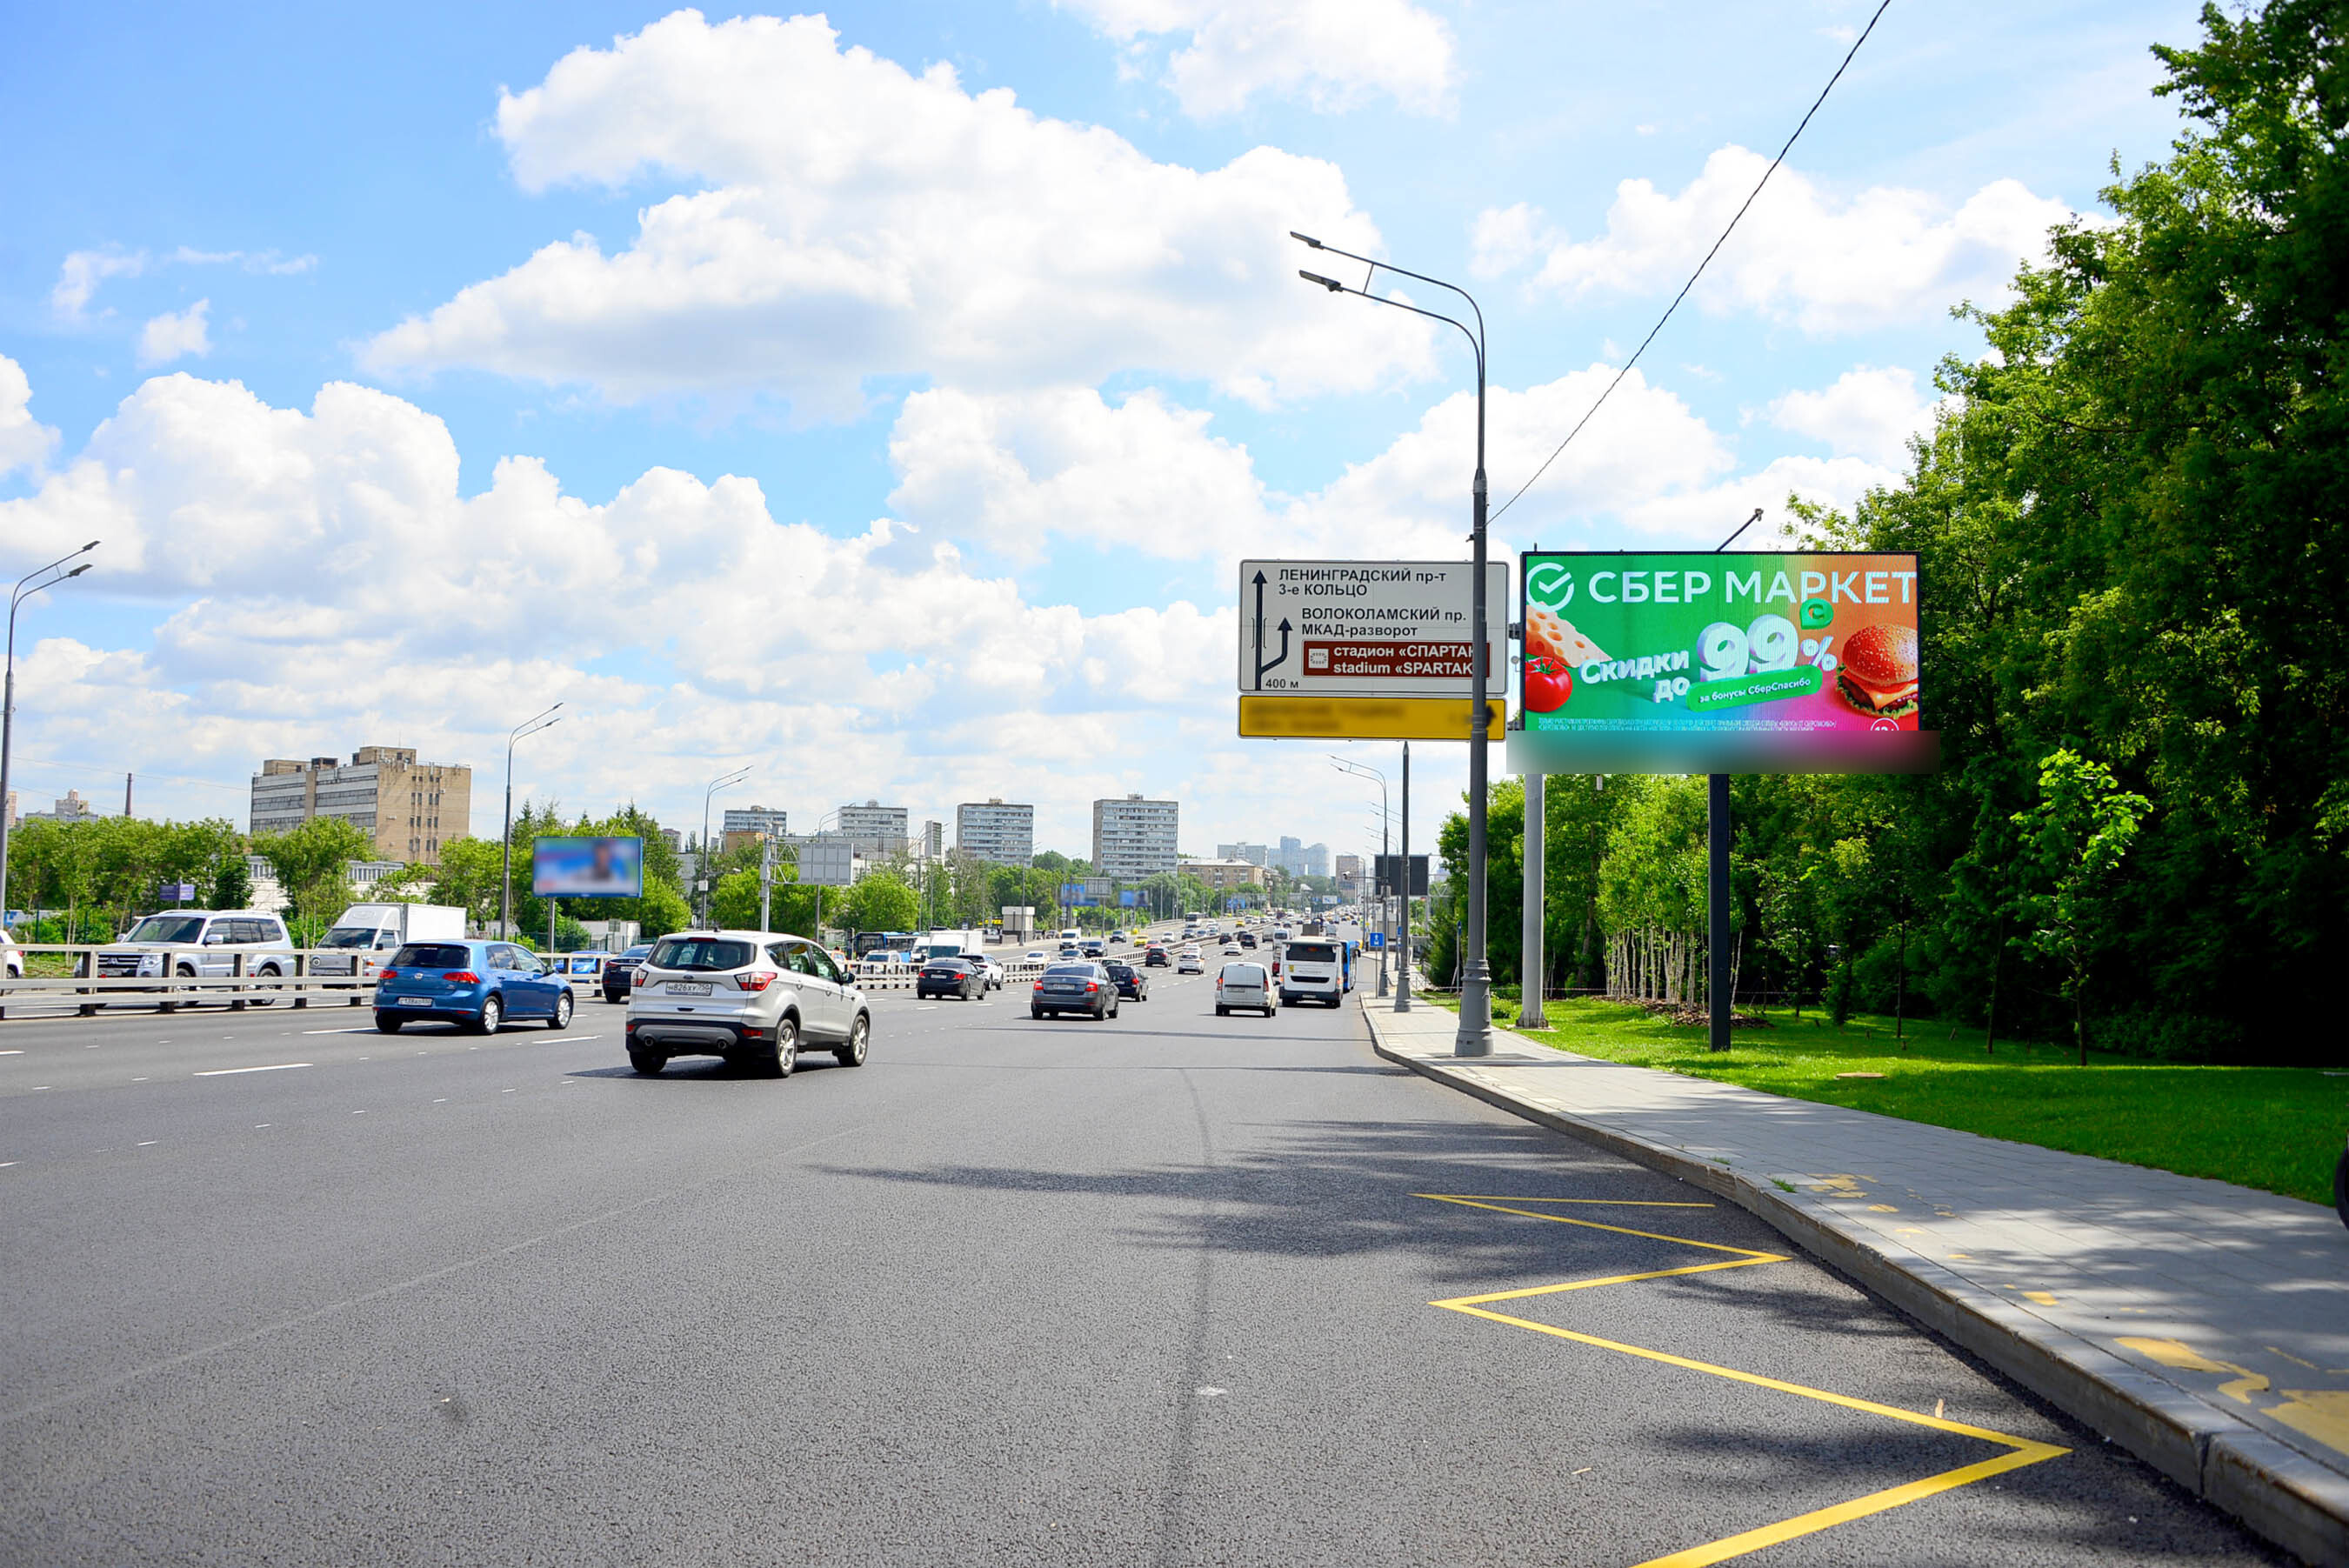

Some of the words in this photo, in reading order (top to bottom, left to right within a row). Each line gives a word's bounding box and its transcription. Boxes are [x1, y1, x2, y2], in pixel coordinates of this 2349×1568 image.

[1278, 568, 1411, 583] ЛЕНИНГРАДСКИЙ
[1416, 572, 1446, 584] пр-т
[1278, 584, 1299, 595] 3-е
[1305, 584, 1367, 597] КОЛЬЦО
[1589, 570, 1712, 603] СБЕР
[1725, 570, 1917, 604] МАРКЕТ
[1302, 607, 1439, 621] ВОЛОКОЛАМСКИЙ
[1445, 612, 1466, 623] пр.
[1302, 624, 1418, 637] МКАД-разворот
[1334, 647, 1394, 657] стадион
[1333, 662, 1391, 675] stadium
[1579, 651, 1690, 684] Скидки
[1265, 678, 1286, 689] 400
[1654, 676, 1691, 703] до
[1712, 690, 1745, 700] бонусы
[1747, 677, 1811, 695] СберСпасибо
